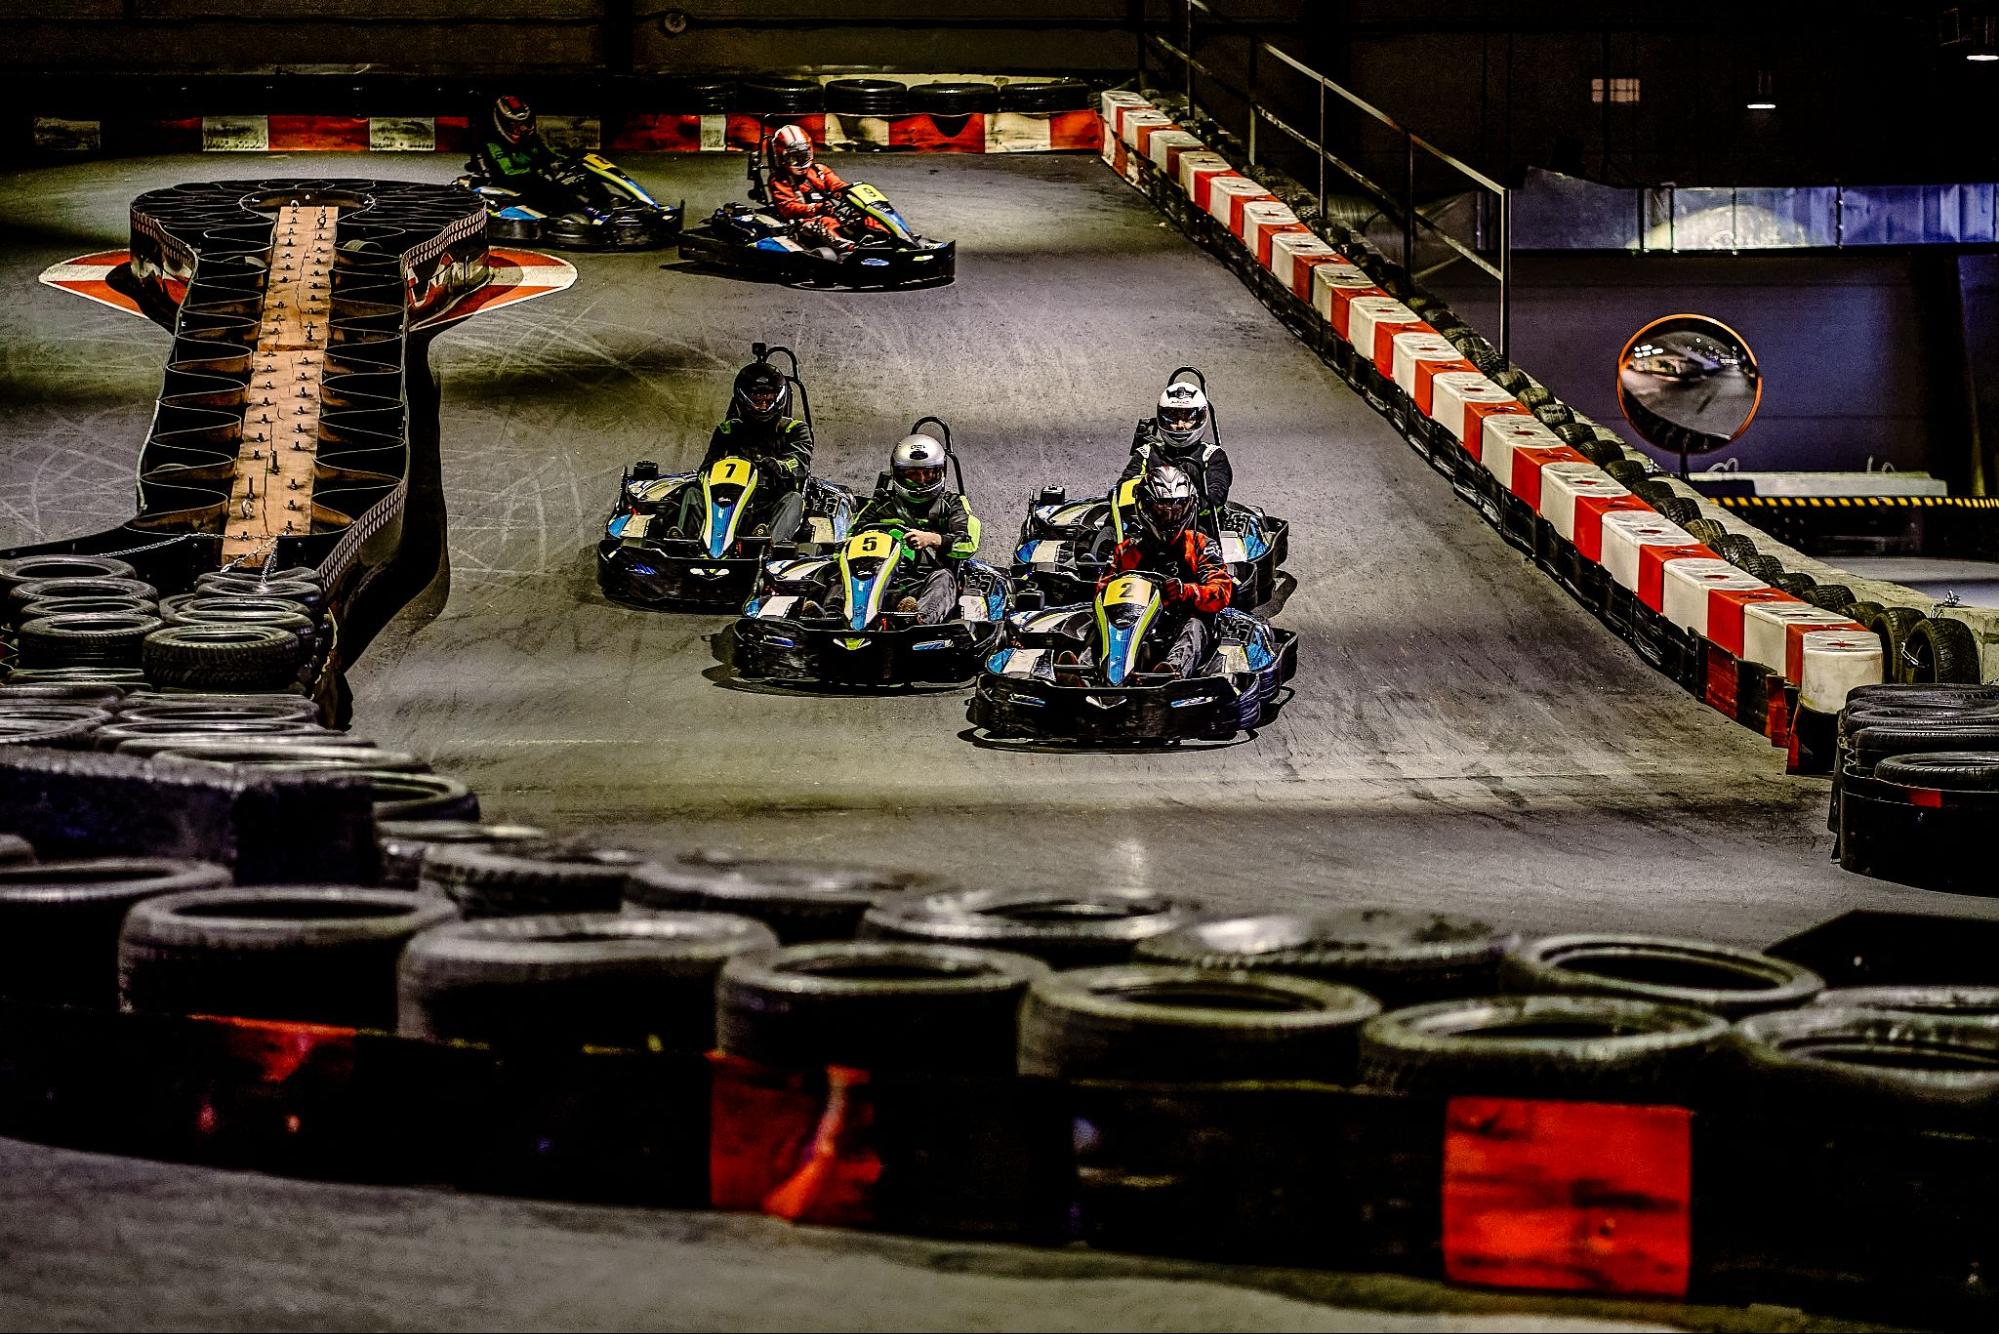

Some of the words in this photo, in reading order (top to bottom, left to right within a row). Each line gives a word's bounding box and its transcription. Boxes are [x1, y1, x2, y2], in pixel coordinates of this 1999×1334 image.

[725, 463, 737, 478] 7
[862, 537, 877, 551] 5
[1119, 582, 1136, 598] 2
